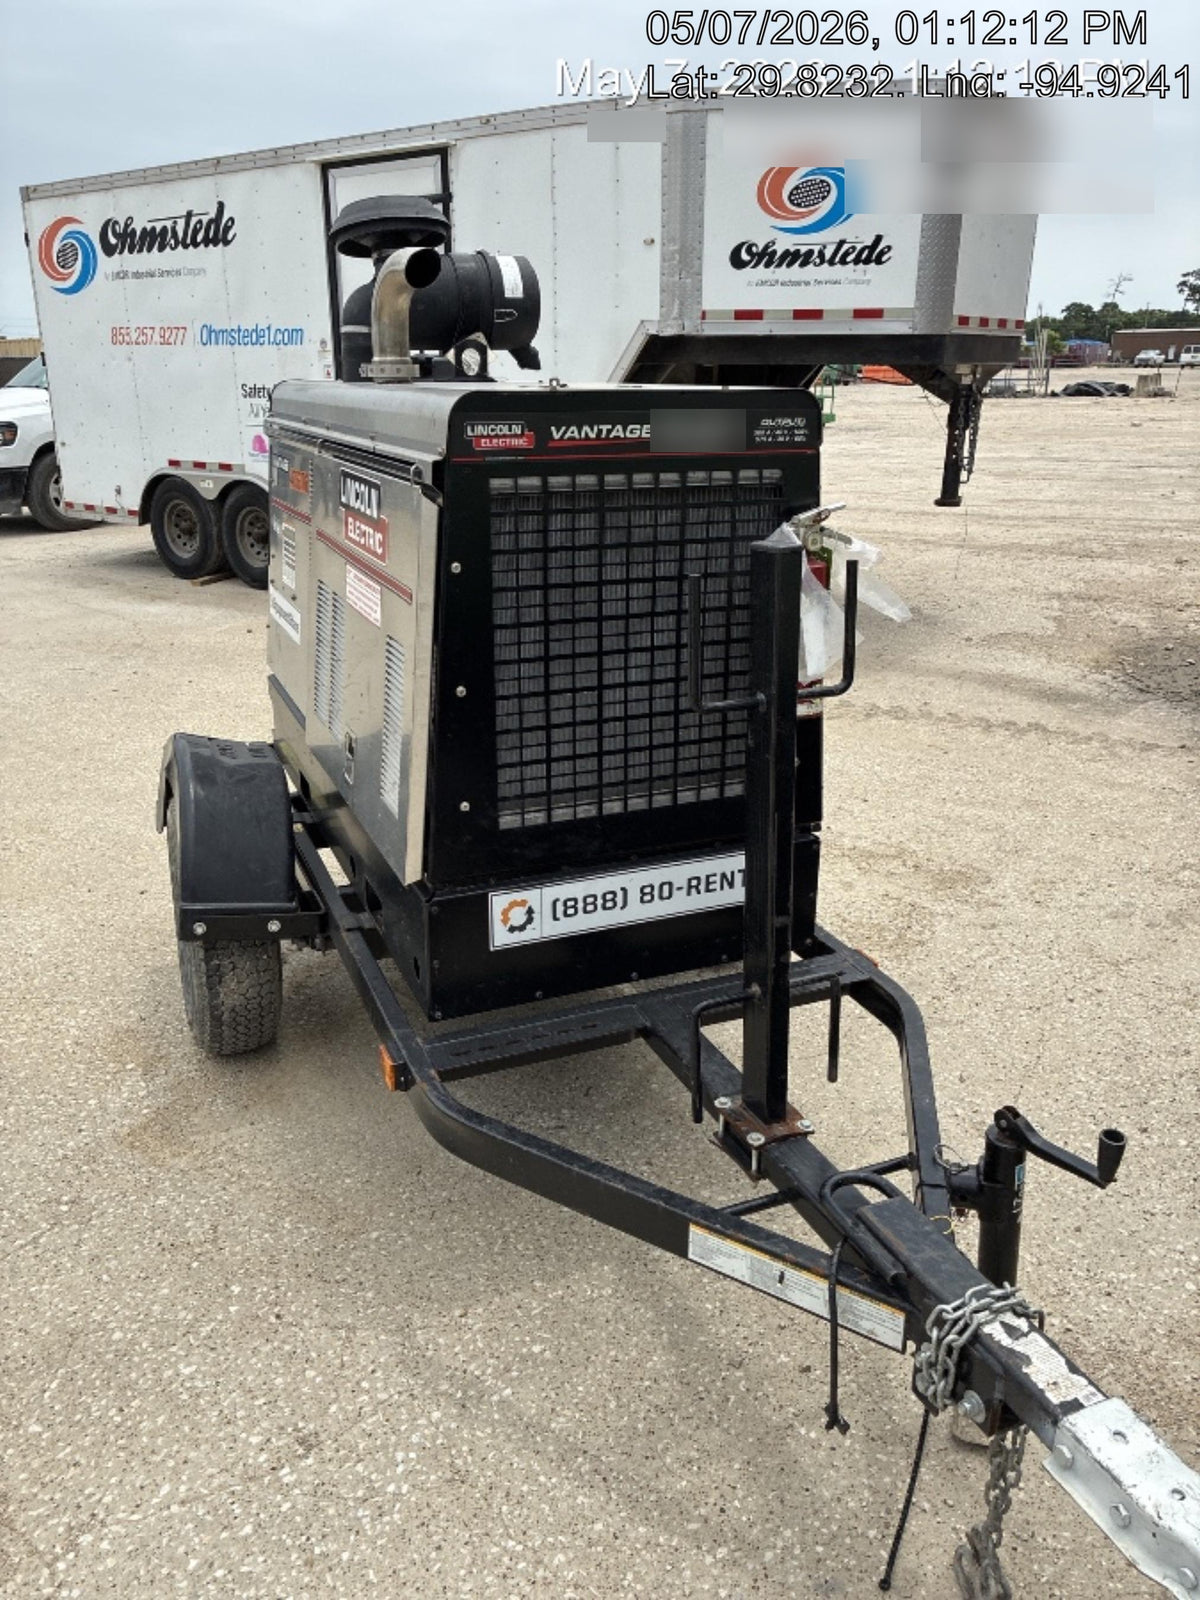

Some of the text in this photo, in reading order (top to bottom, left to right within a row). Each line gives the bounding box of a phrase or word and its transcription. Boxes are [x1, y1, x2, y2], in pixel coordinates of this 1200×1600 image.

[99, 200, 237, 258] Ohmstede
[729, 234, 893, 270] Ohmstede
[111, 326, 187, 346] 855.257.9277
[200, 323, 304, 347] Ohmstede1.com
[466, 424, 522, 436] LINCOLN
[480, 436, 529, 447] ELECTRIC
[340, 473, 380, 519] LINCOLN
[347, 516, 384, 556] ELECTRIC
[551, 886, 629, 922] (888)
